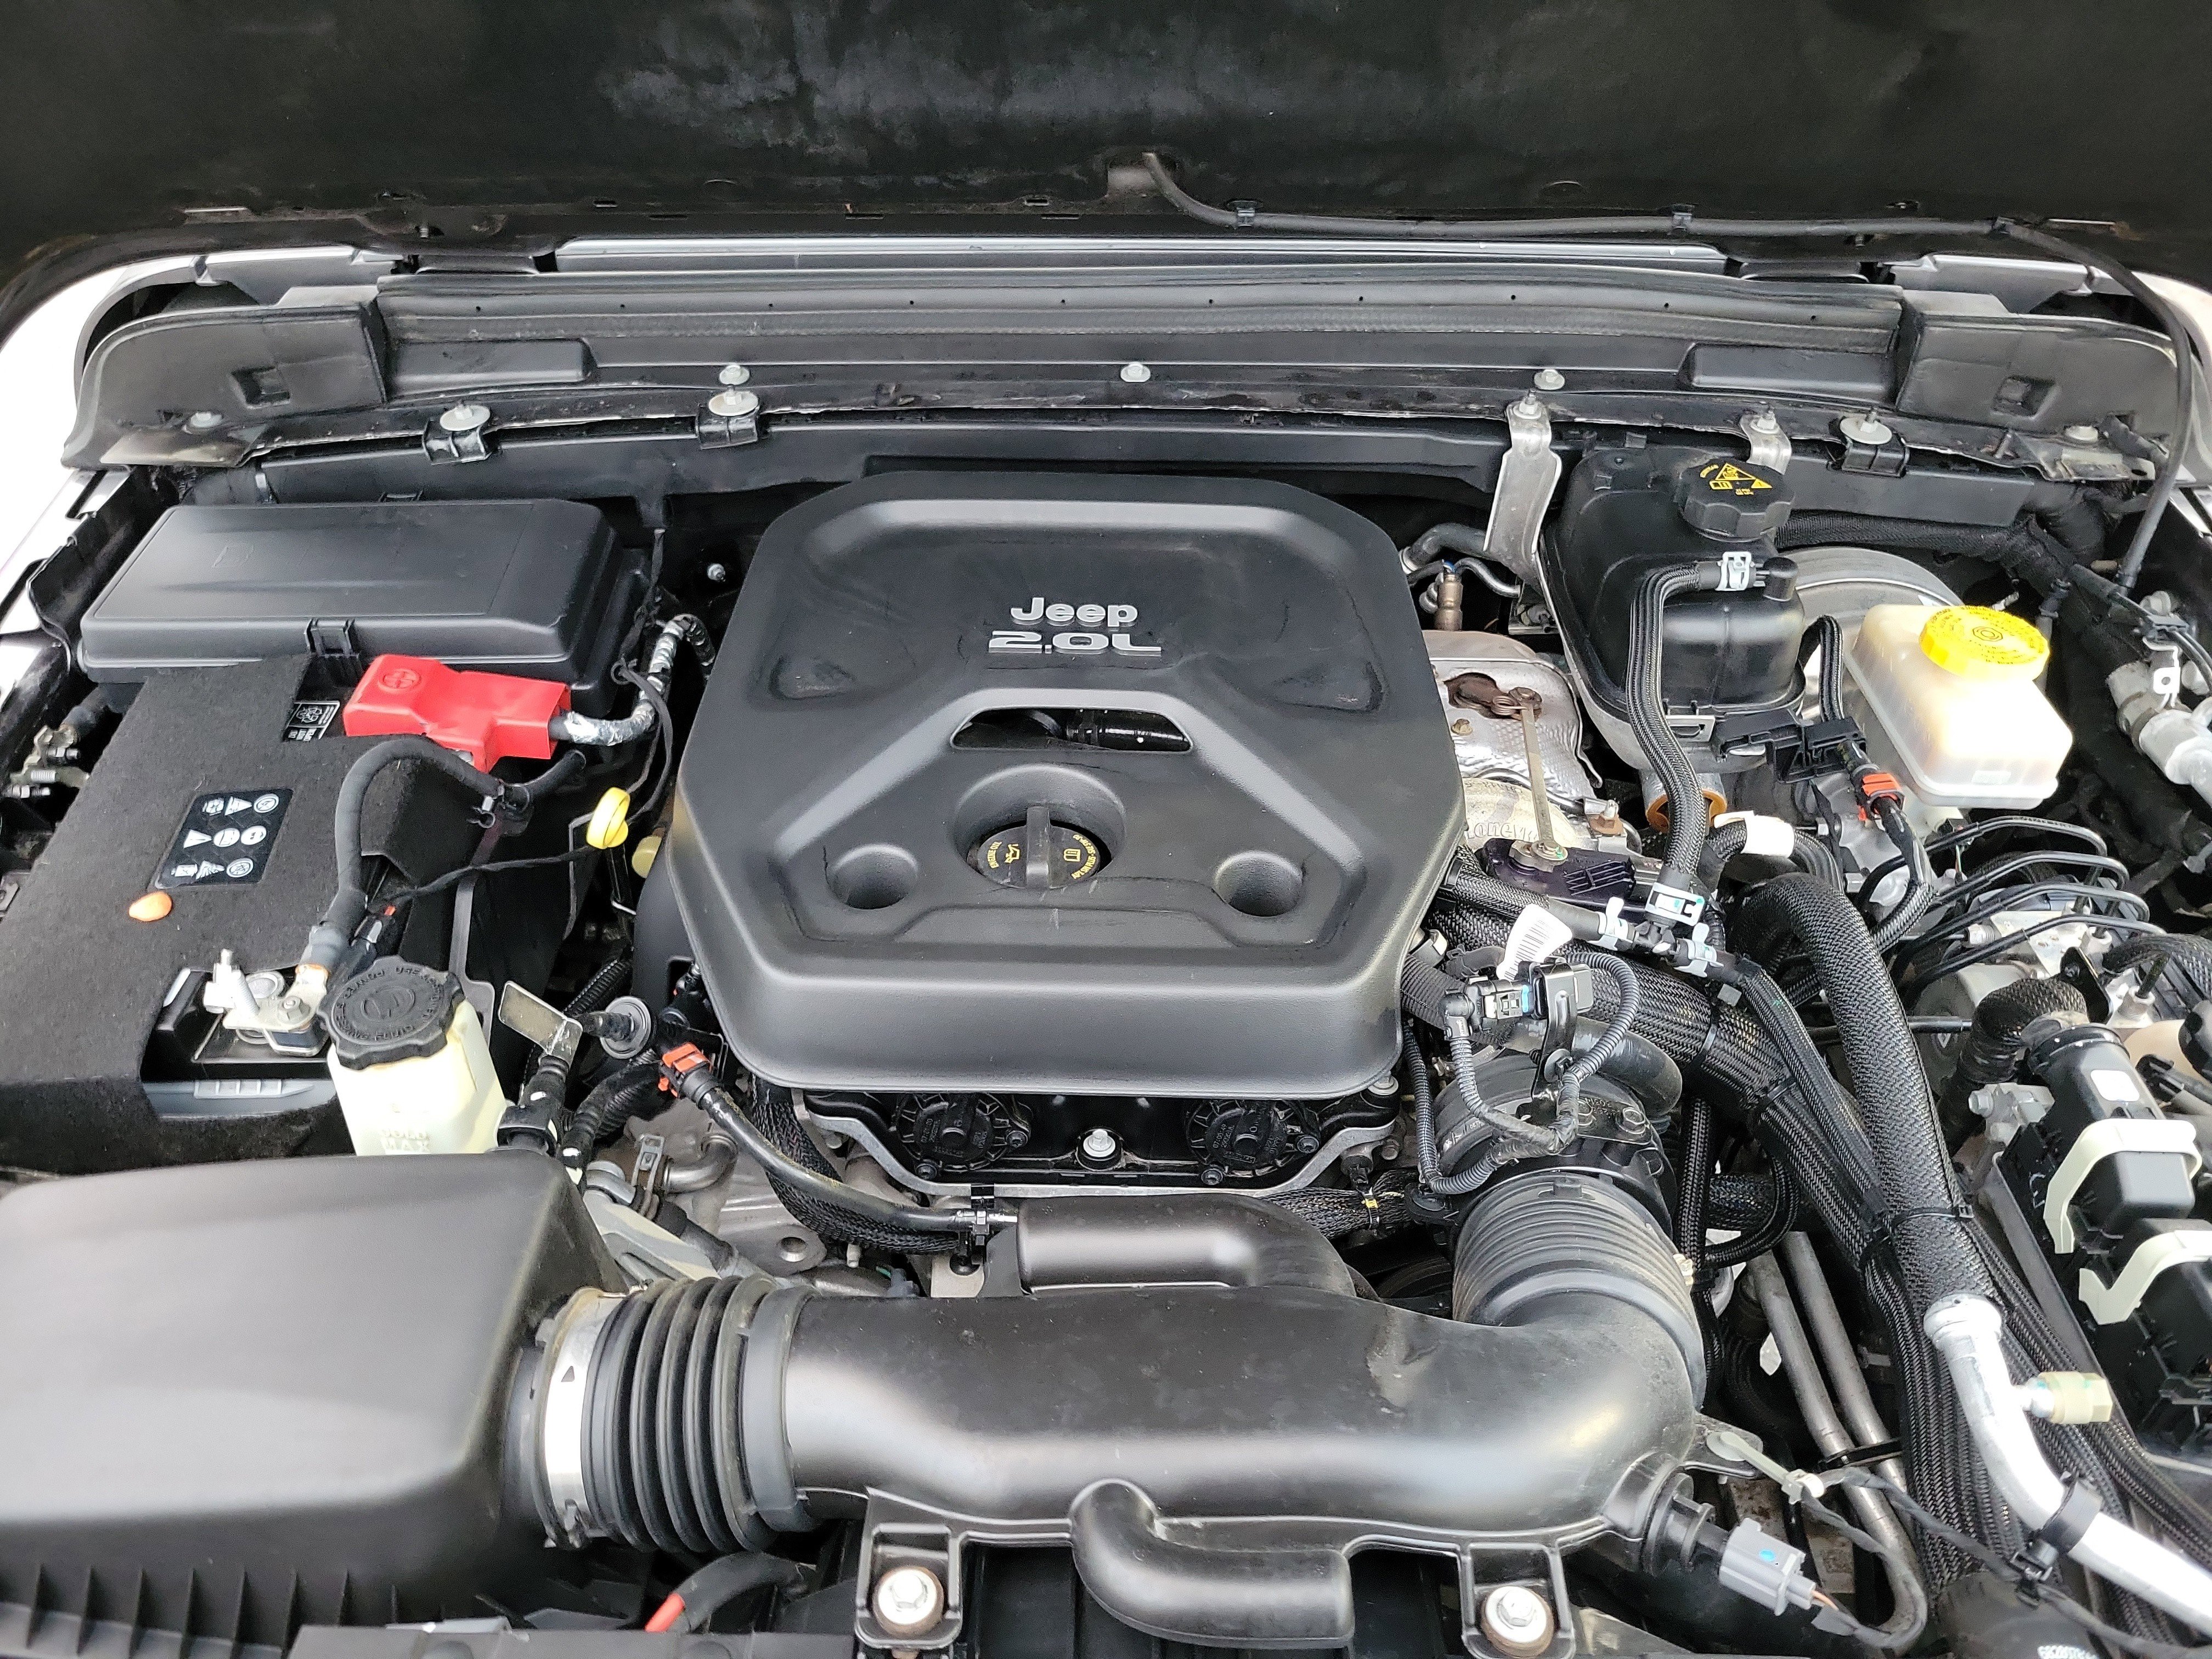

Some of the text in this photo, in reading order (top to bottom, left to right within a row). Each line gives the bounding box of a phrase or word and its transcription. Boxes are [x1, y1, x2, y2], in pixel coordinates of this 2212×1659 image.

[1011, 597, 1084, 629] Jeep
[988, 630, 1161, 656] 2.0L
[987, 841, 1002, 868] ENGINE OIL
